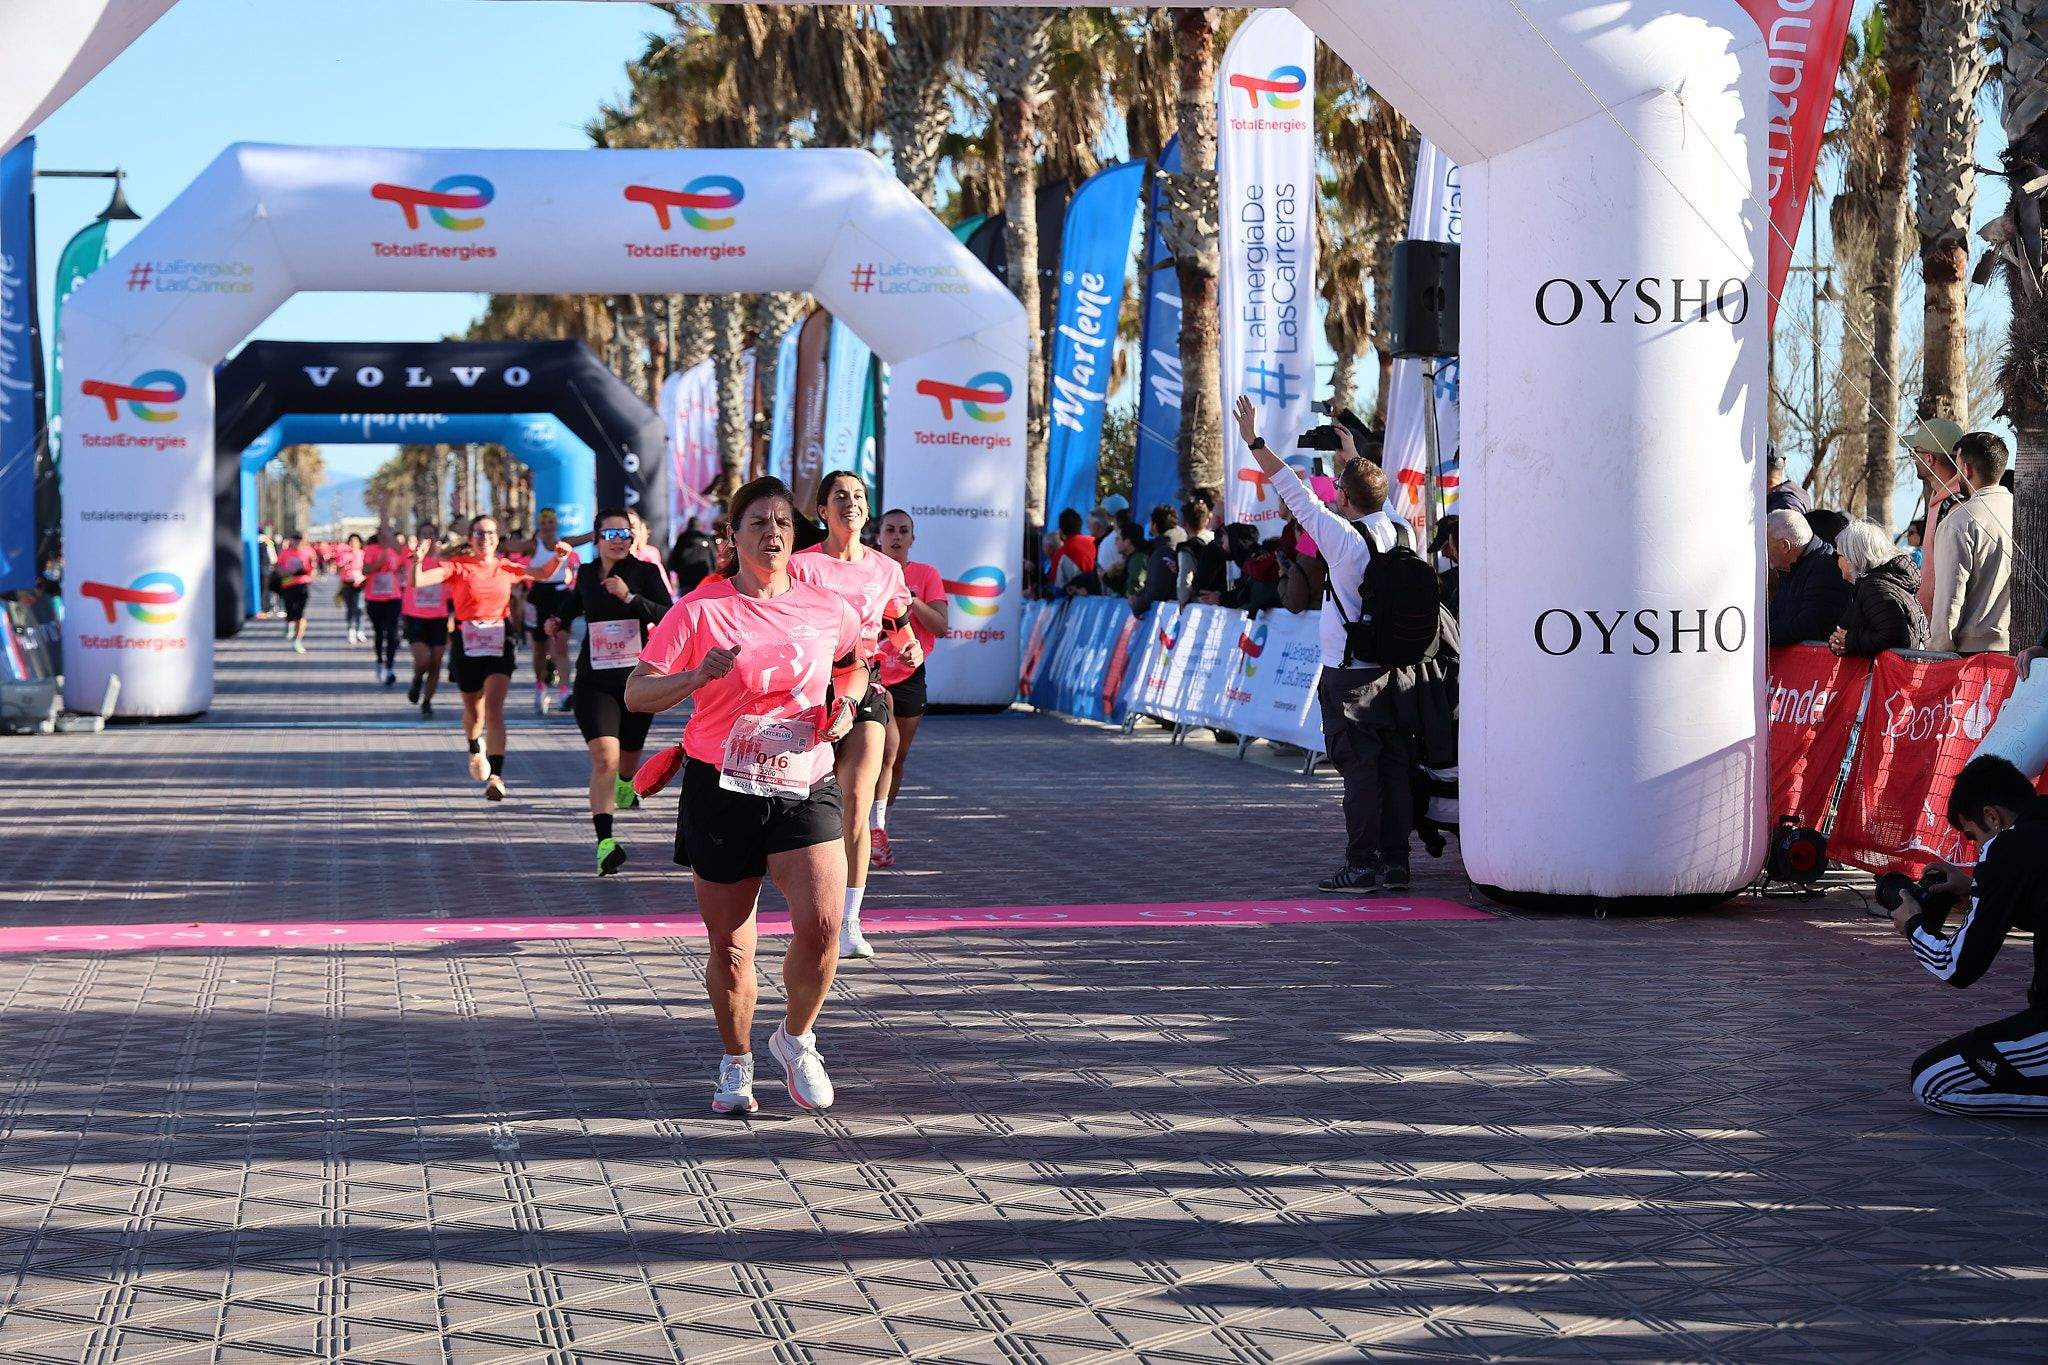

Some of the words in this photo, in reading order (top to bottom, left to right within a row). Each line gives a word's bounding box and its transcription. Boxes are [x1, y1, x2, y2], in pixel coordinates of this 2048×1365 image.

[1230, 119, 1306, 133] TotalEnergies
[371, 242, 497, 261] TotalEnergies
[624, 242, 746, 261] TotalEnergies
[1272, 183, 1299, 354] LasCarreras
[1535, 277, 1749, 326] OYSHO
[1052, 271, 1113, 433] Marlene
[302, 366, 531, 388] VOLVO
[82, 432, 187, 451] TotalEnergies
[914, 431, 1012, 450] TotalEnergies
[911, 505, 1008, 519] totalenergies.es
[944, 626, 1006, 643] Energies
[1534, 606, 1747, 656] OYSHO
[80, 634, 187, 652] TotalEnergies
[1767, 676, 1838, 727] tander
[757, 752, 789, 769] 016
[861, 911, 1069, 923] YSHO
